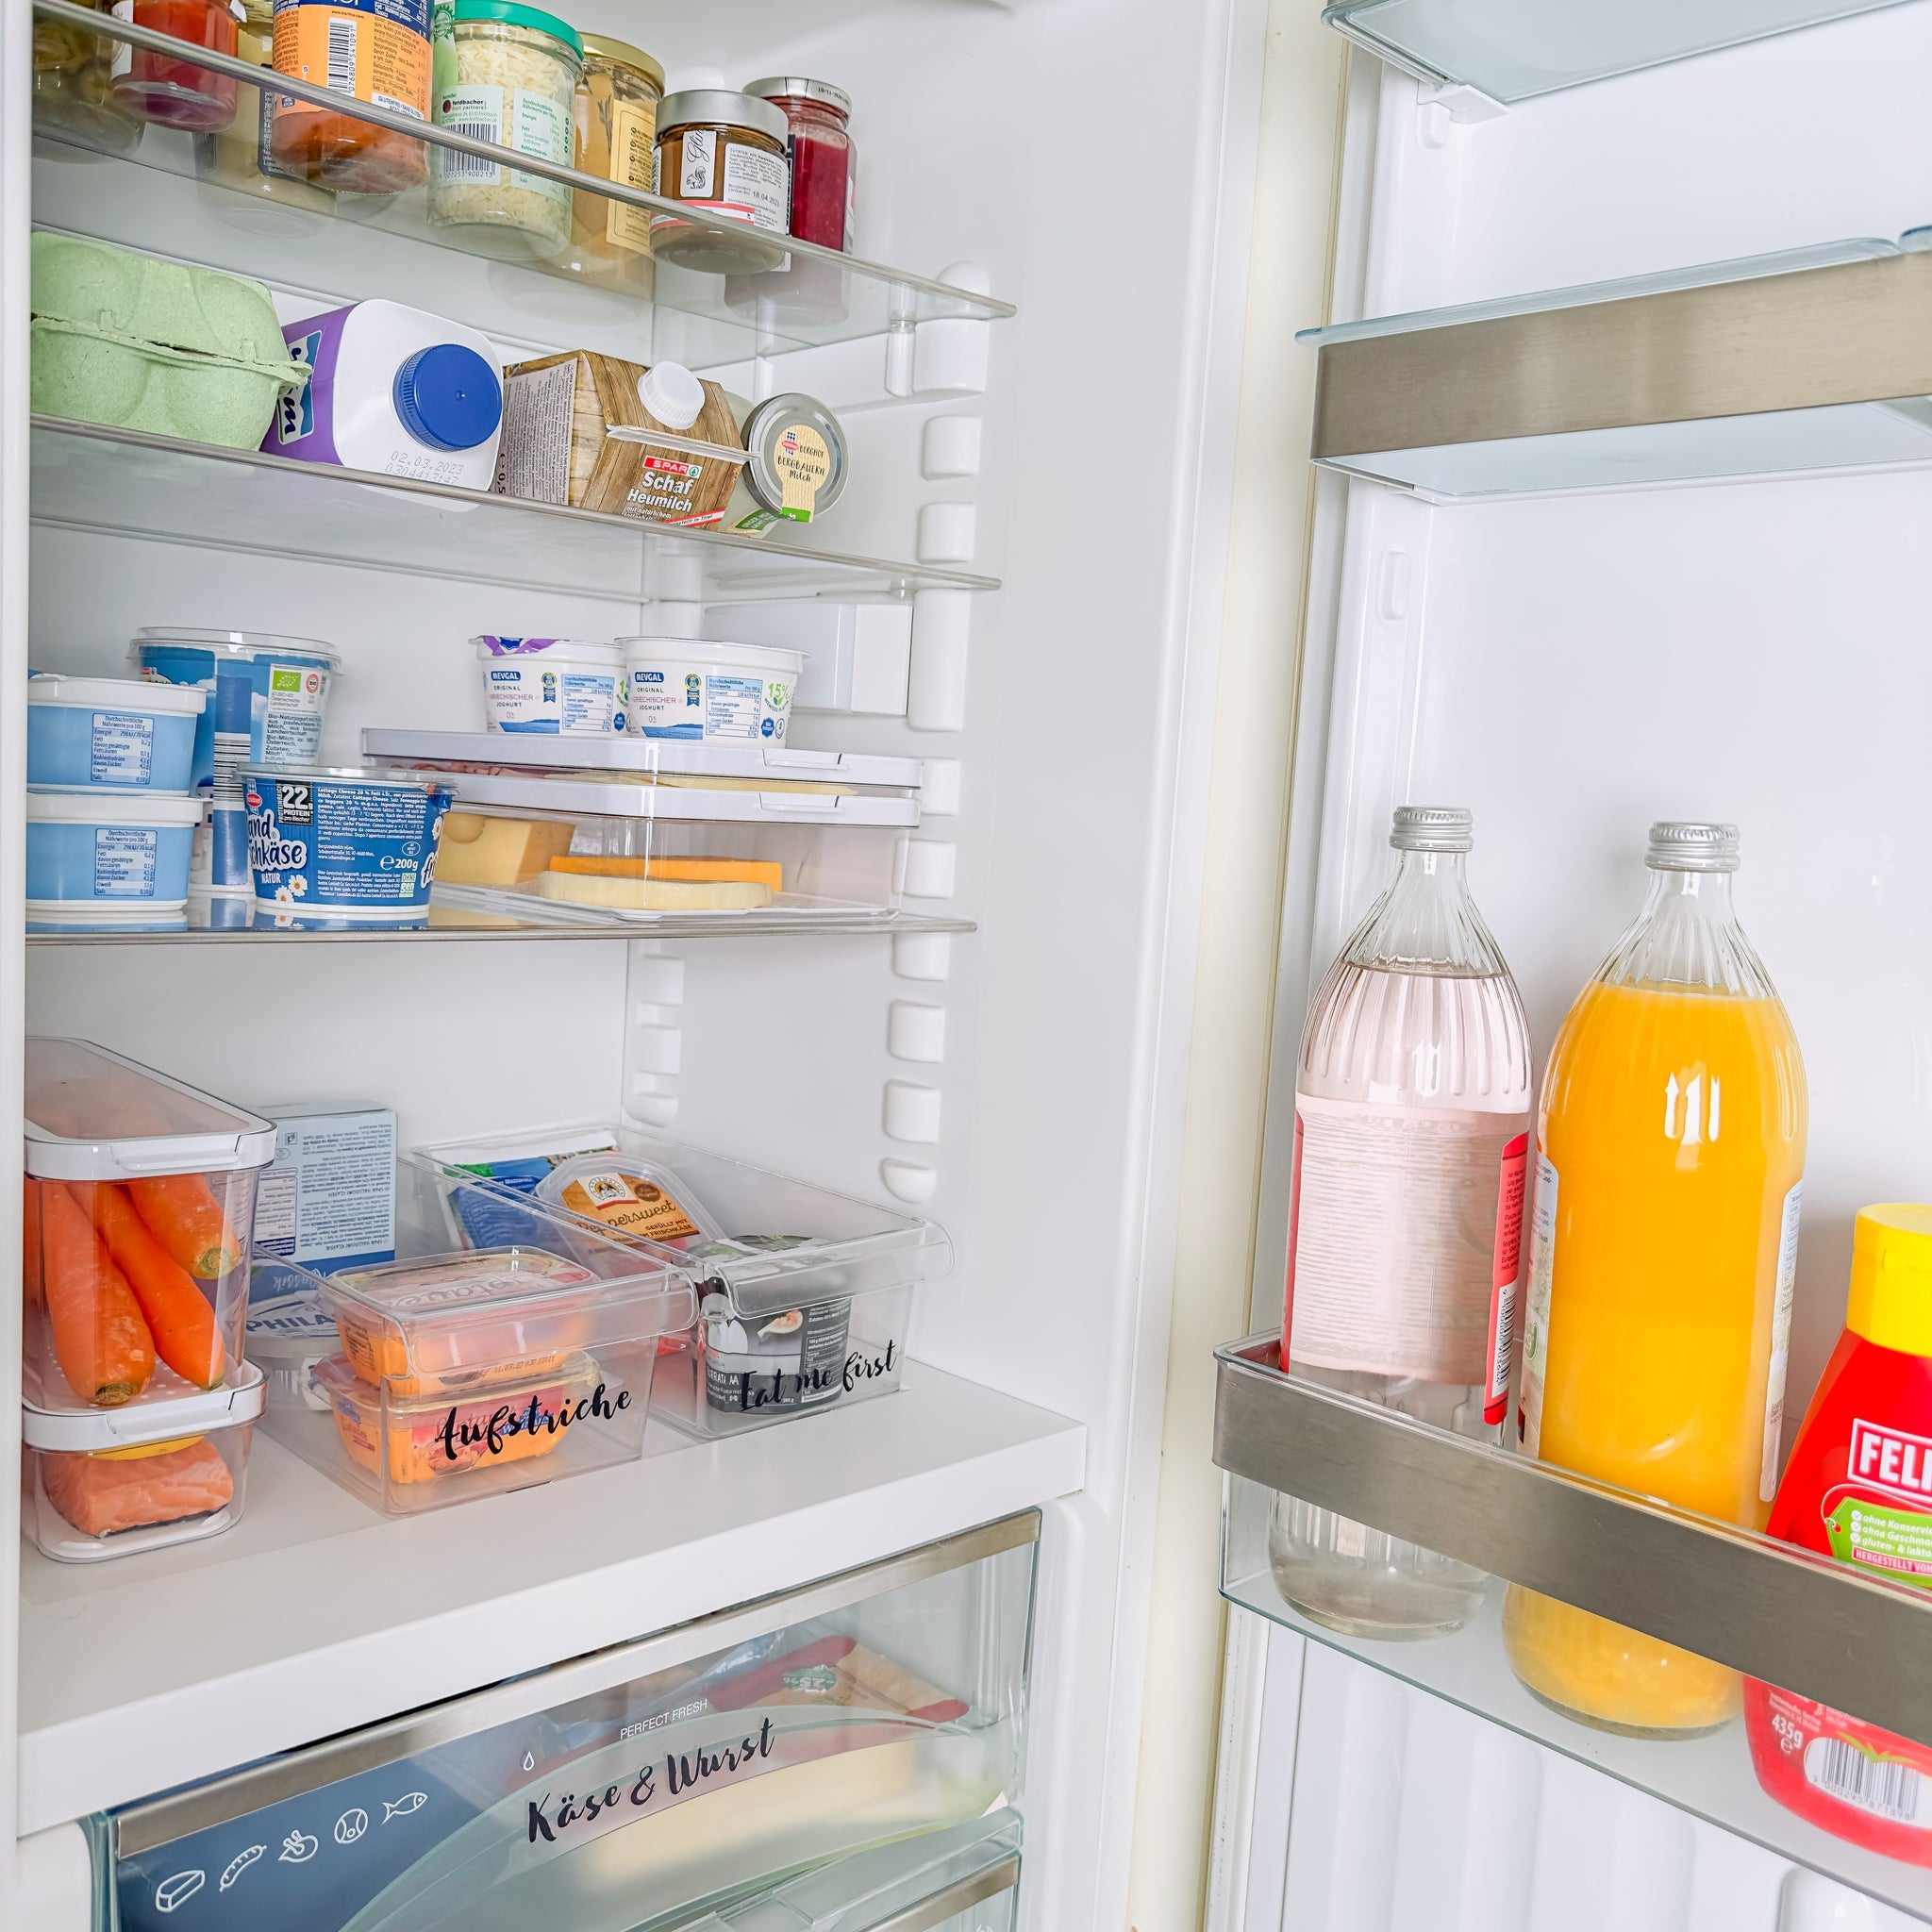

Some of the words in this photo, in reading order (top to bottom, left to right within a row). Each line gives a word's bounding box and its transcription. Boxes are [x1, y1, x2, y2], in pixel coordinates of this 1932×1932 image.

[653, 459, 688, 474] SPAR
[642, 471, 694, 495] Schaf
[626, 488, 693, 512] Heumilch
[248, 813, 272, 840] and
[261, 873, 282, 884] NATUR
[645, 1221, 675, 1230] GEFÜLLT
[740, 1368, 789, 1412] Eat
[796, 1368, 832, 1393] me
[842, 1339, 897, 1392] first
[435, 1383, 631, 1461] Aufstriche
[1859, 1430, 1932, 1492] FELI
[1863, 1515, 1886, 1526] ohne
[1862, 1525, 1885, 1538] ohne
[1888, 1531, 1932, 1546] Geschma
[1862, 1538, 1895, 1551] gluten-
[1897, 1544, 1905, 1554] &
[1856, 1549, 1912, 1571] HERGESTELLT
[1914, 1562, 1932, 1574] VON
[620, 1712, 669, 1740] PERFECT
[672, 1698, 708, 1726] FRESH
[1772, 1713, 1803, 1750] 435g
[528, 1781, 622, 1843] Käse
[629, 1765, 657, 1807] &
[666, 1717, 775, 1796] Wurst
